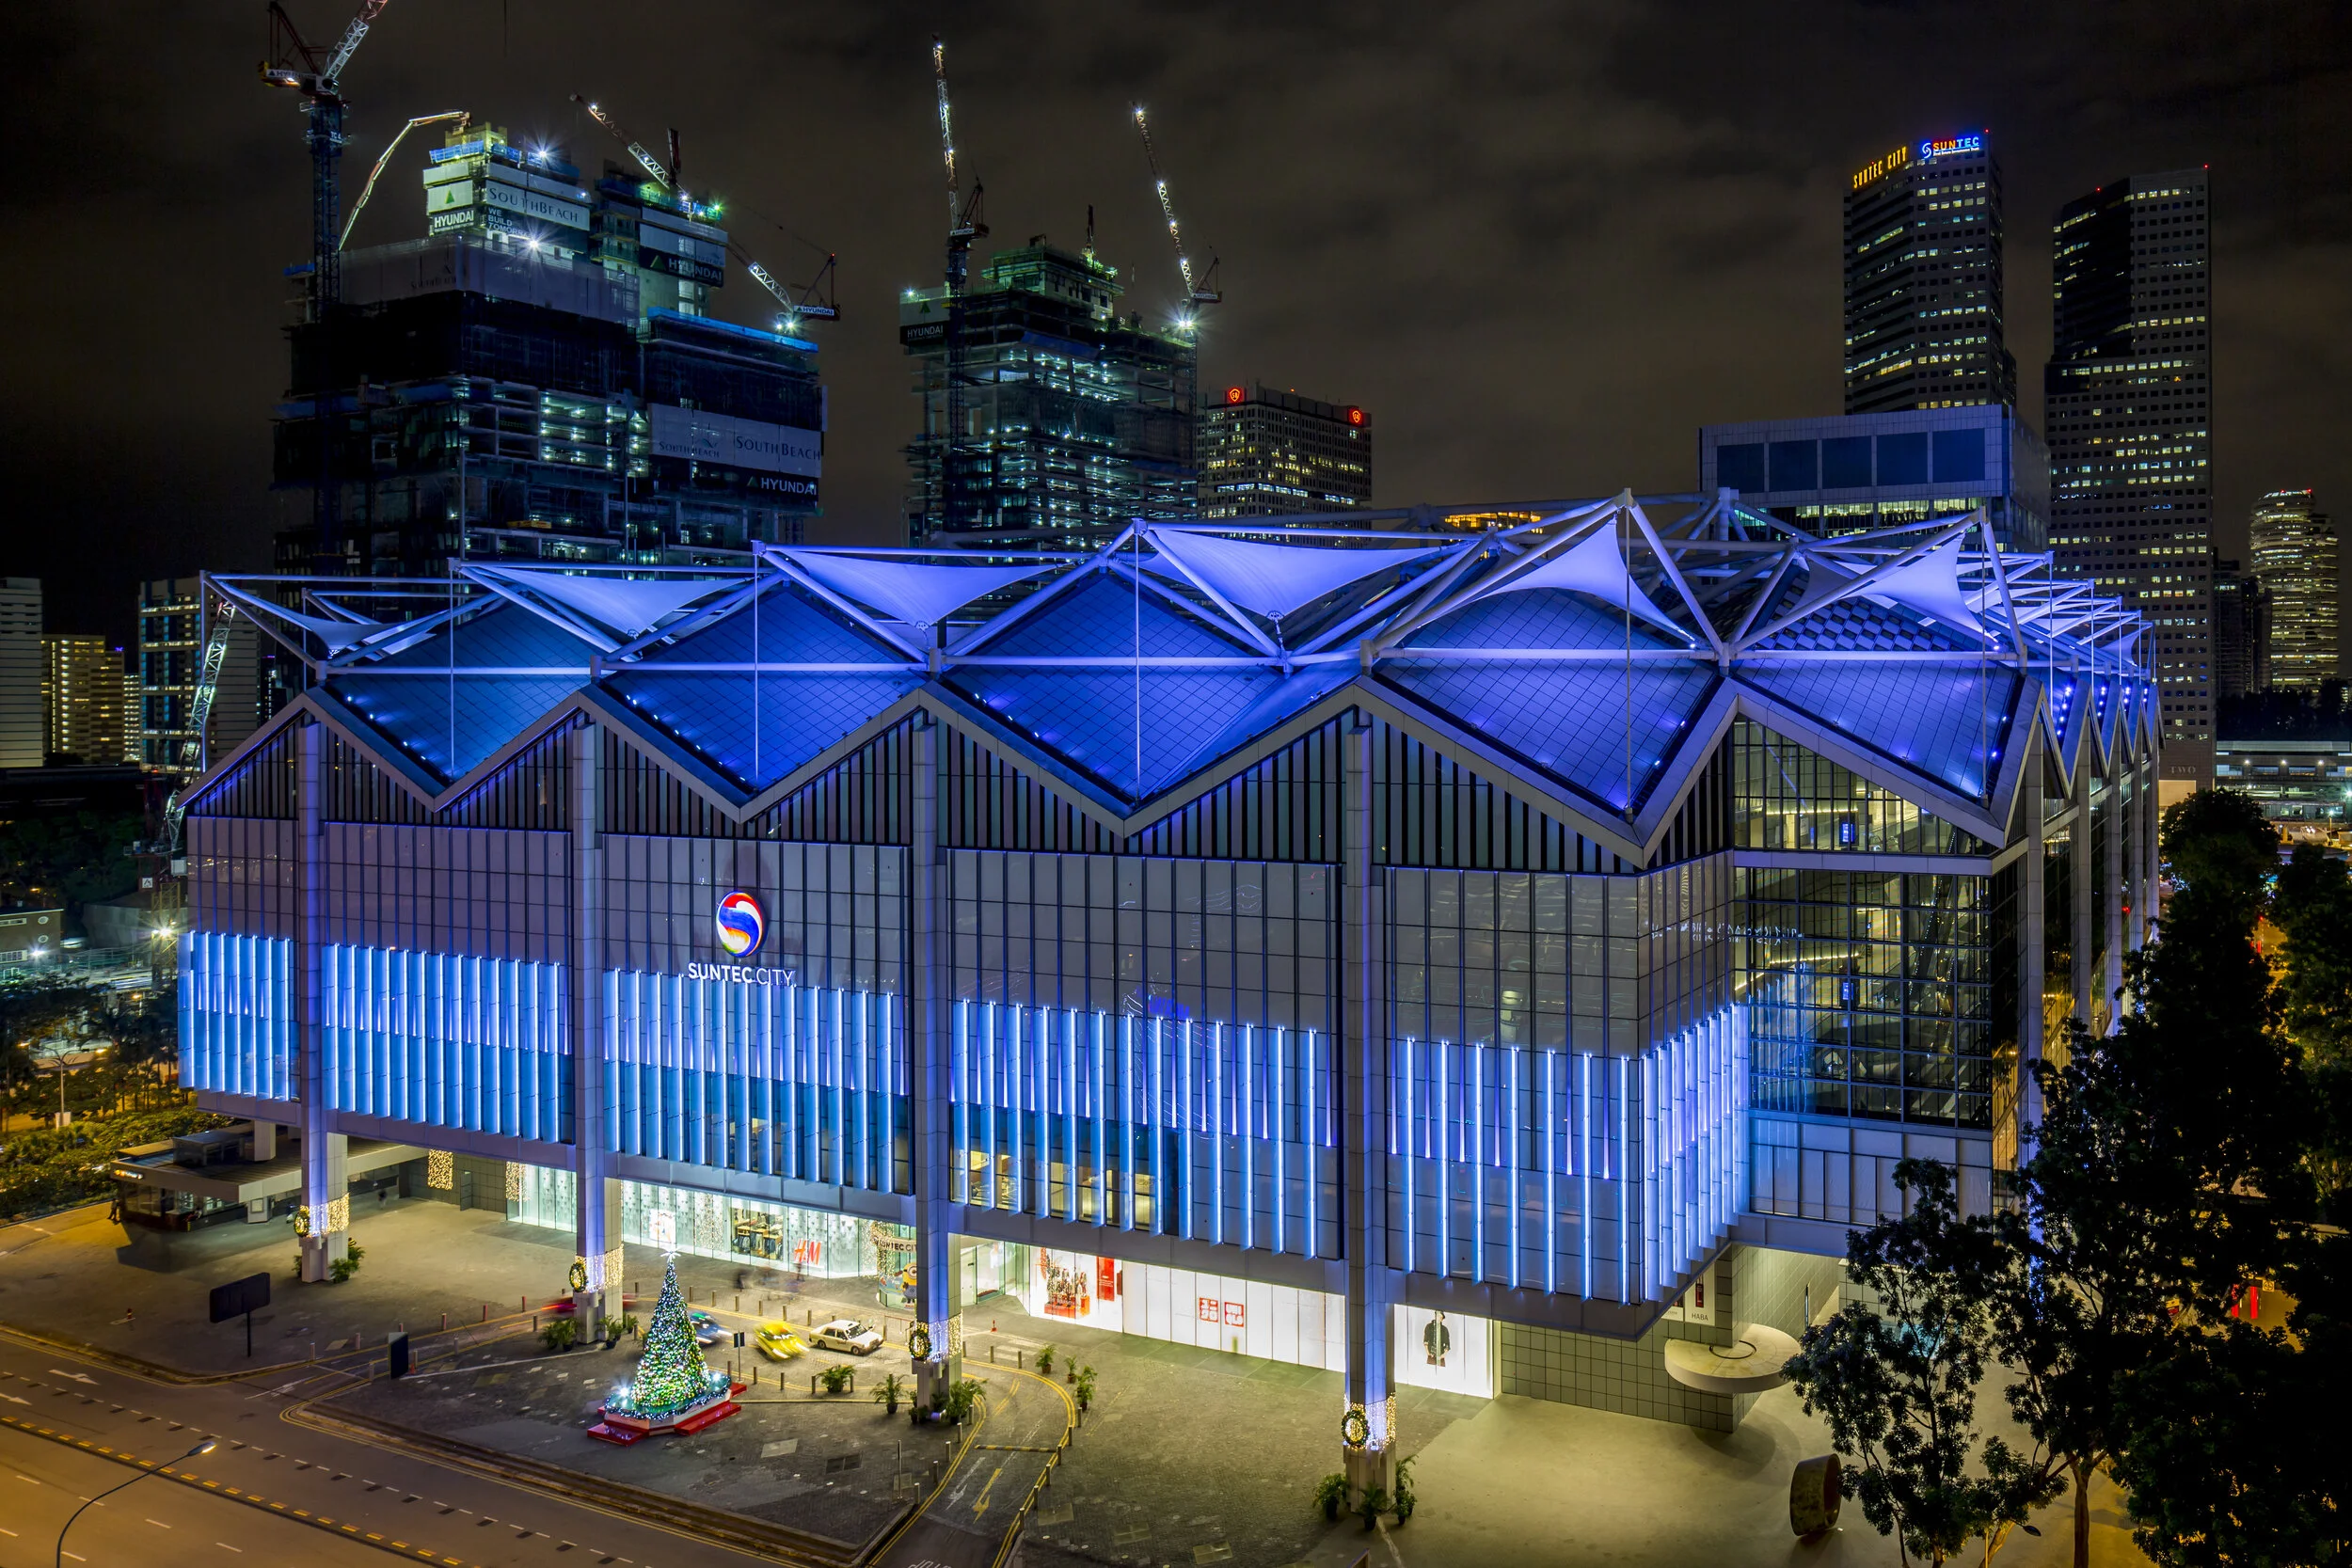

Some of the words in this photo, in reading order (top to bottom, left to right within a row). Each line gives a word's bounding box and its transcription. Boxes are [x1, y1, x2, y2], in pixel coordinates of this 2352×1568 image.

[1933, 136, 1979, 150] SUNTEC
[1853, 160, 1883, 188] SUNTEC
[1887, 146, 1907, 169] CITY
[488, 207, 502, 216] WE
[434, 210, 474, 229] HYUNDAI
[487, 214, 513, 227] BUILD
[488, 222, 529, 236] TOMORR
[803, 307, 834, 315] HYUNDAI
[907, 325, 944, 339] HYUNDAI
[761, 477, 817, 496] HYUNDAI
[2169, 766, 2196, 774] TWO
[688, 962, 753, 984] SUNTEC
[756, 967, 794, 987] CITY
[1692, 1312, 1708, 1321] HABA
